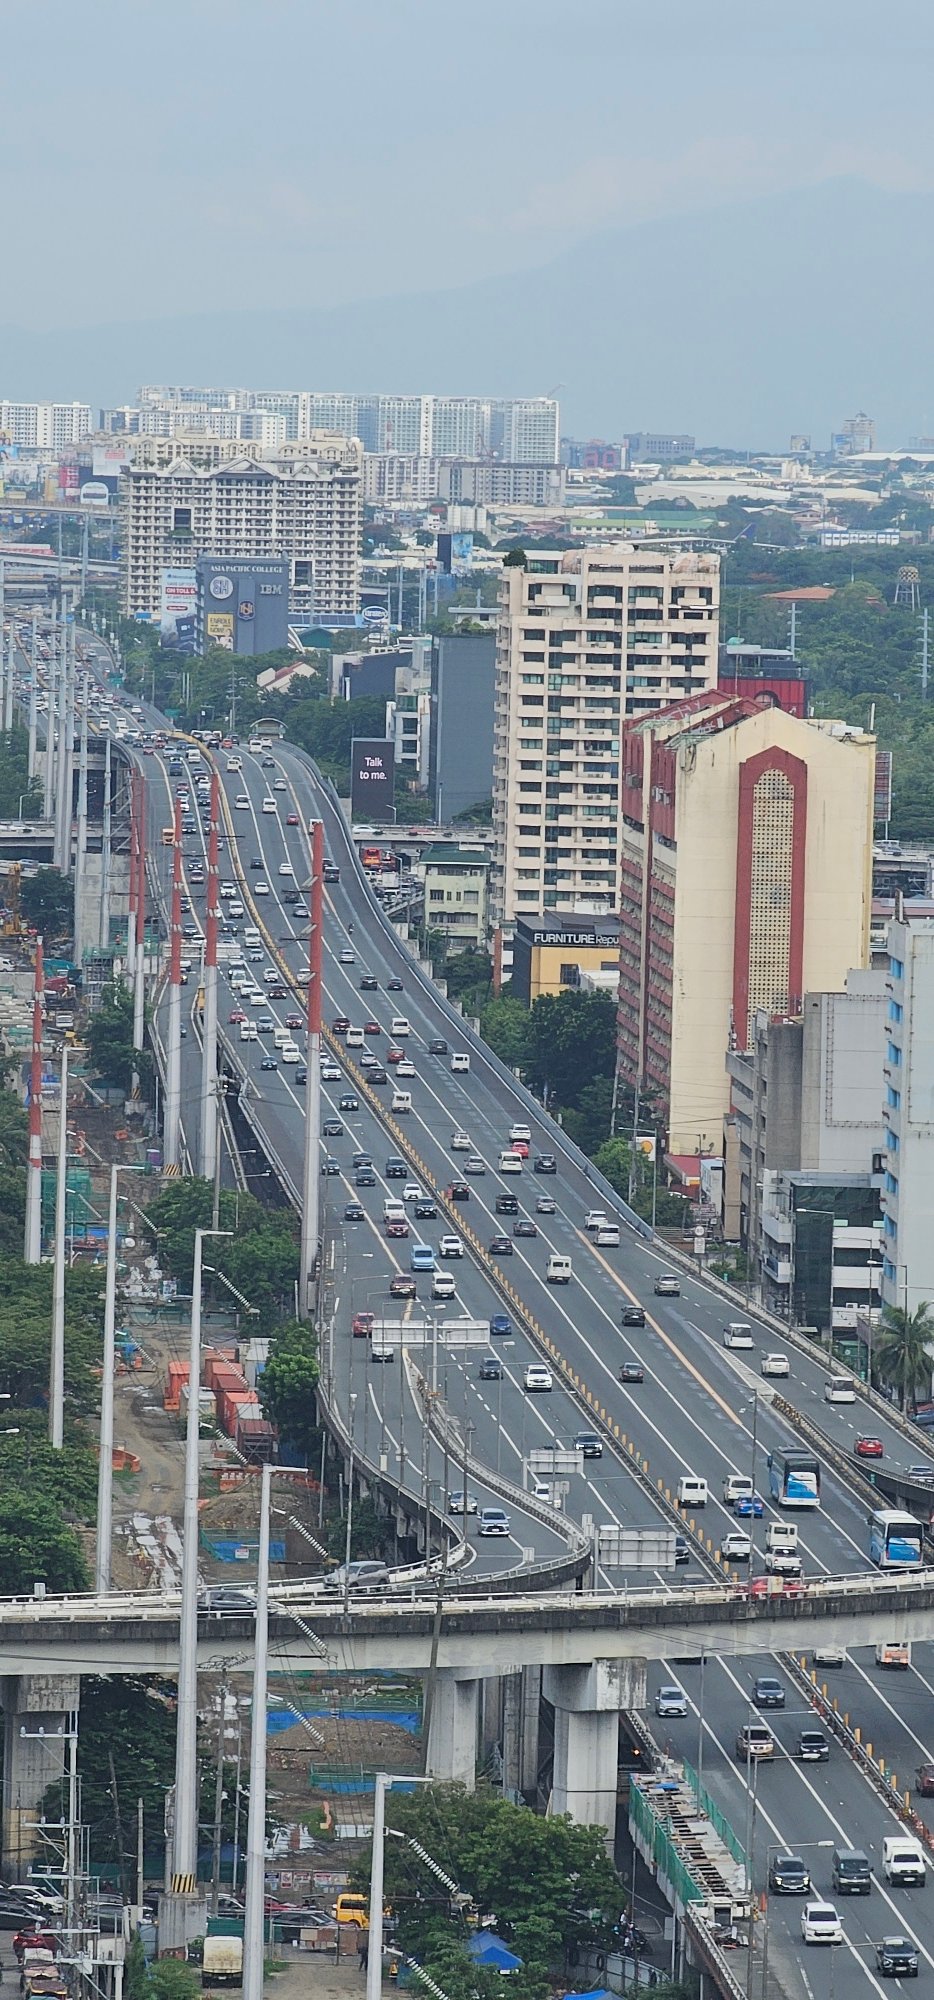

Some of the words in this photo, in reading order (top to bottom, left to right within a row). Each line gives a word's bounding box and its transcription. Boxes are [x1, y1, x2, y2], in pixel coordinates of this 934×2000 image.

[226, 565, 251, 573] PACIFIC
[260, 584, 283, 595] IBM
[364, 757, 383, 767] Talk
[360, 770, 370, 780] to
[371, 772, 387, 780] me.
[534, 933, 595, 943] FURNITURE
